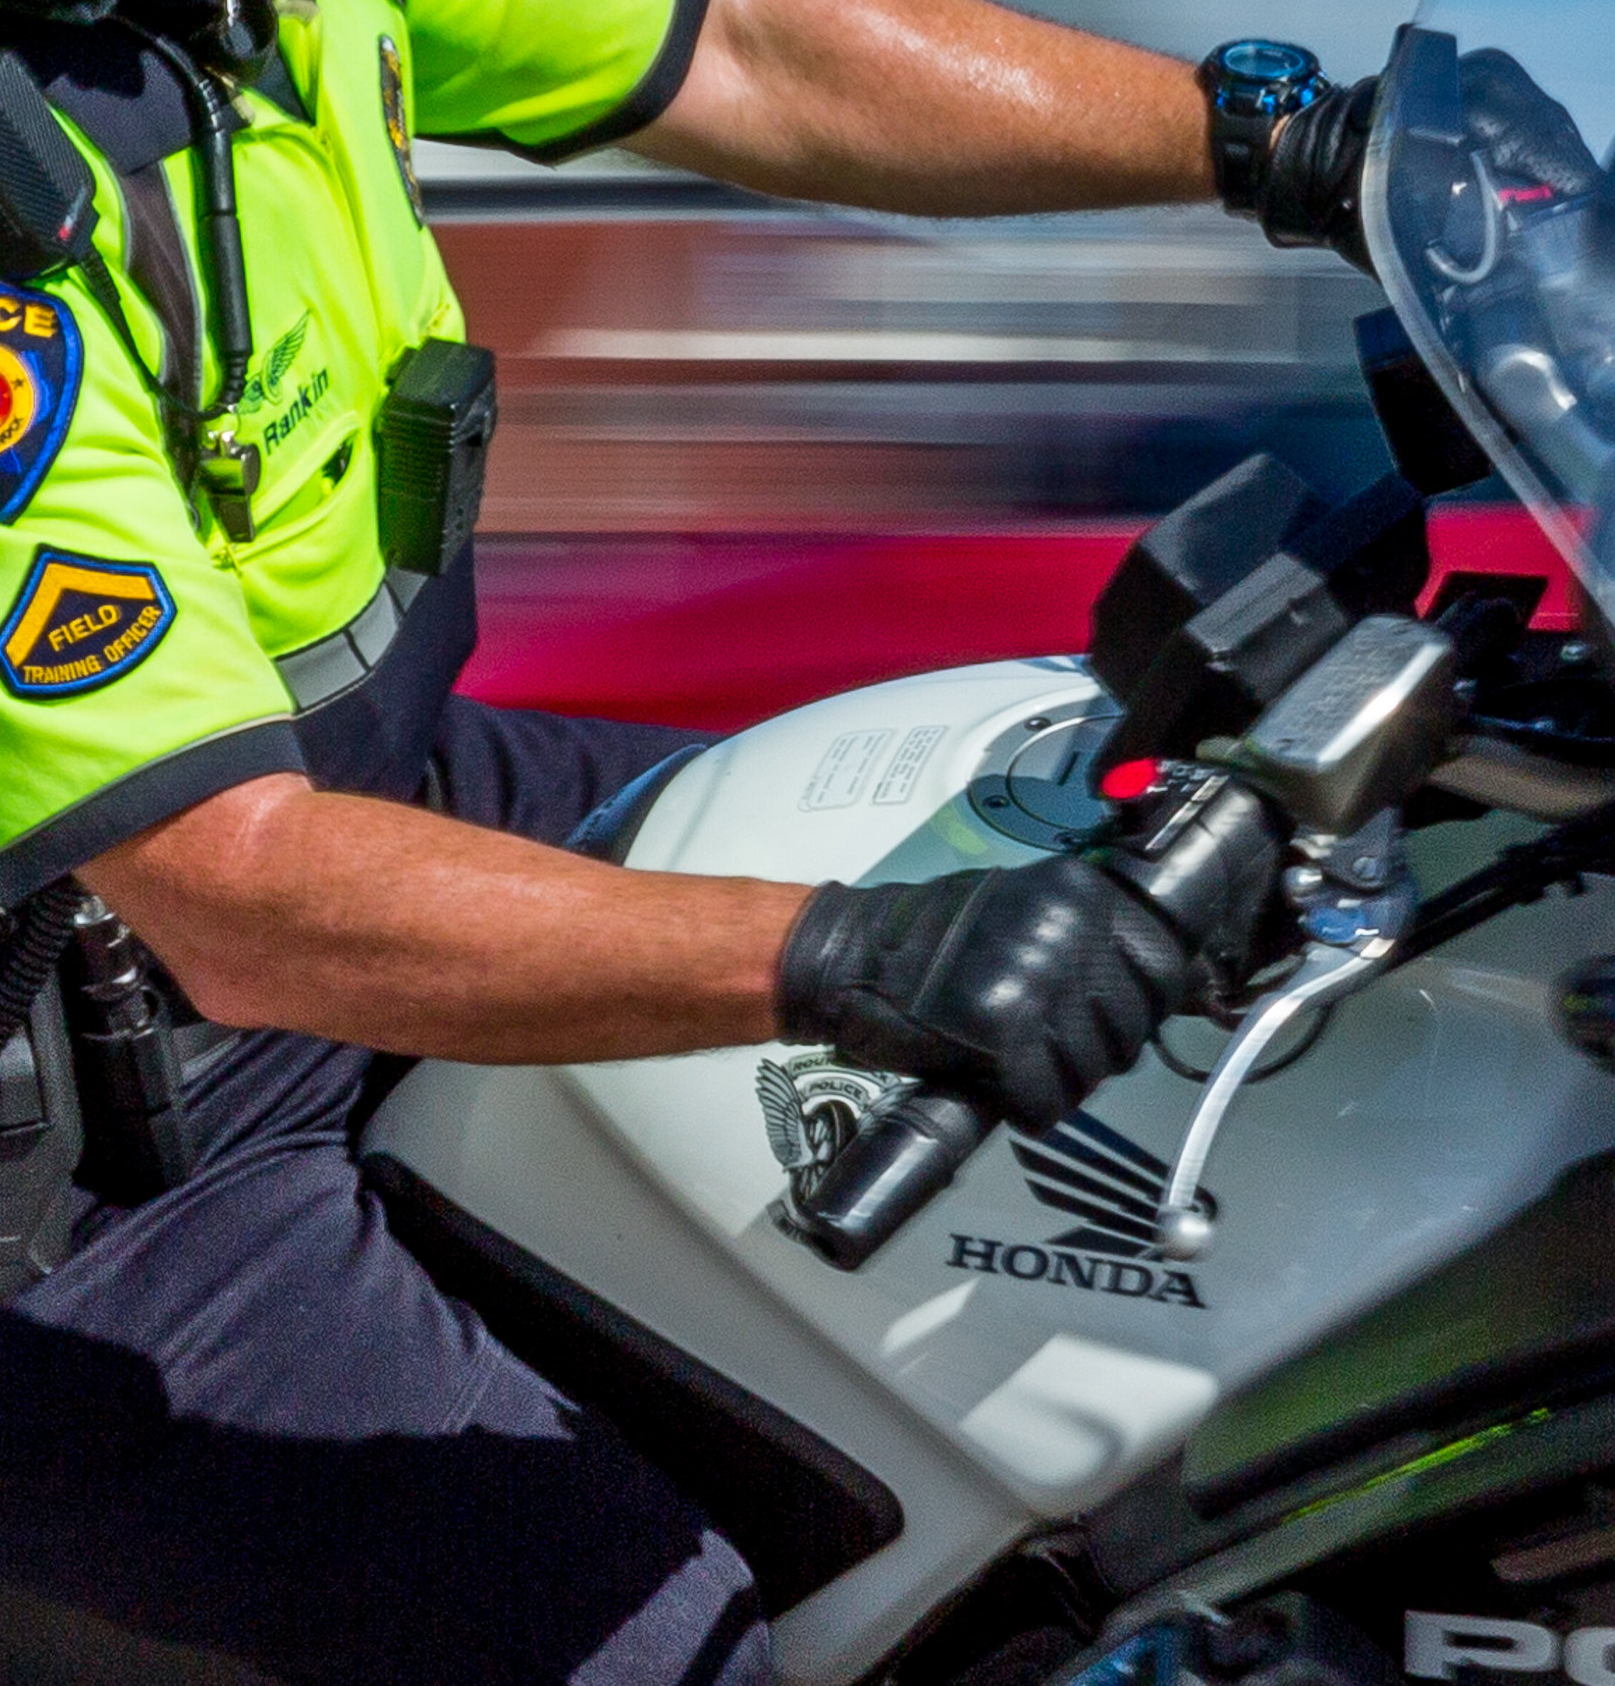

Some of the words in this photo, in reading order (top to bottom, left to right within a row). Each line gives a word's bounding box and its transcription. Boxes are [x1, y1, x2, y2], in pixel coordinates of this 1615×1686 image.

[263, 369, 329, 456] Rankin
[23, 655, 102, 684] TRAINING
[103, 605, 162, 663] OFFICER
[48, 604, 121, 652] FIELD
[809, 1078, 863, 1100] POLICE
[945, 1232, 1209, 1310] HONDA
